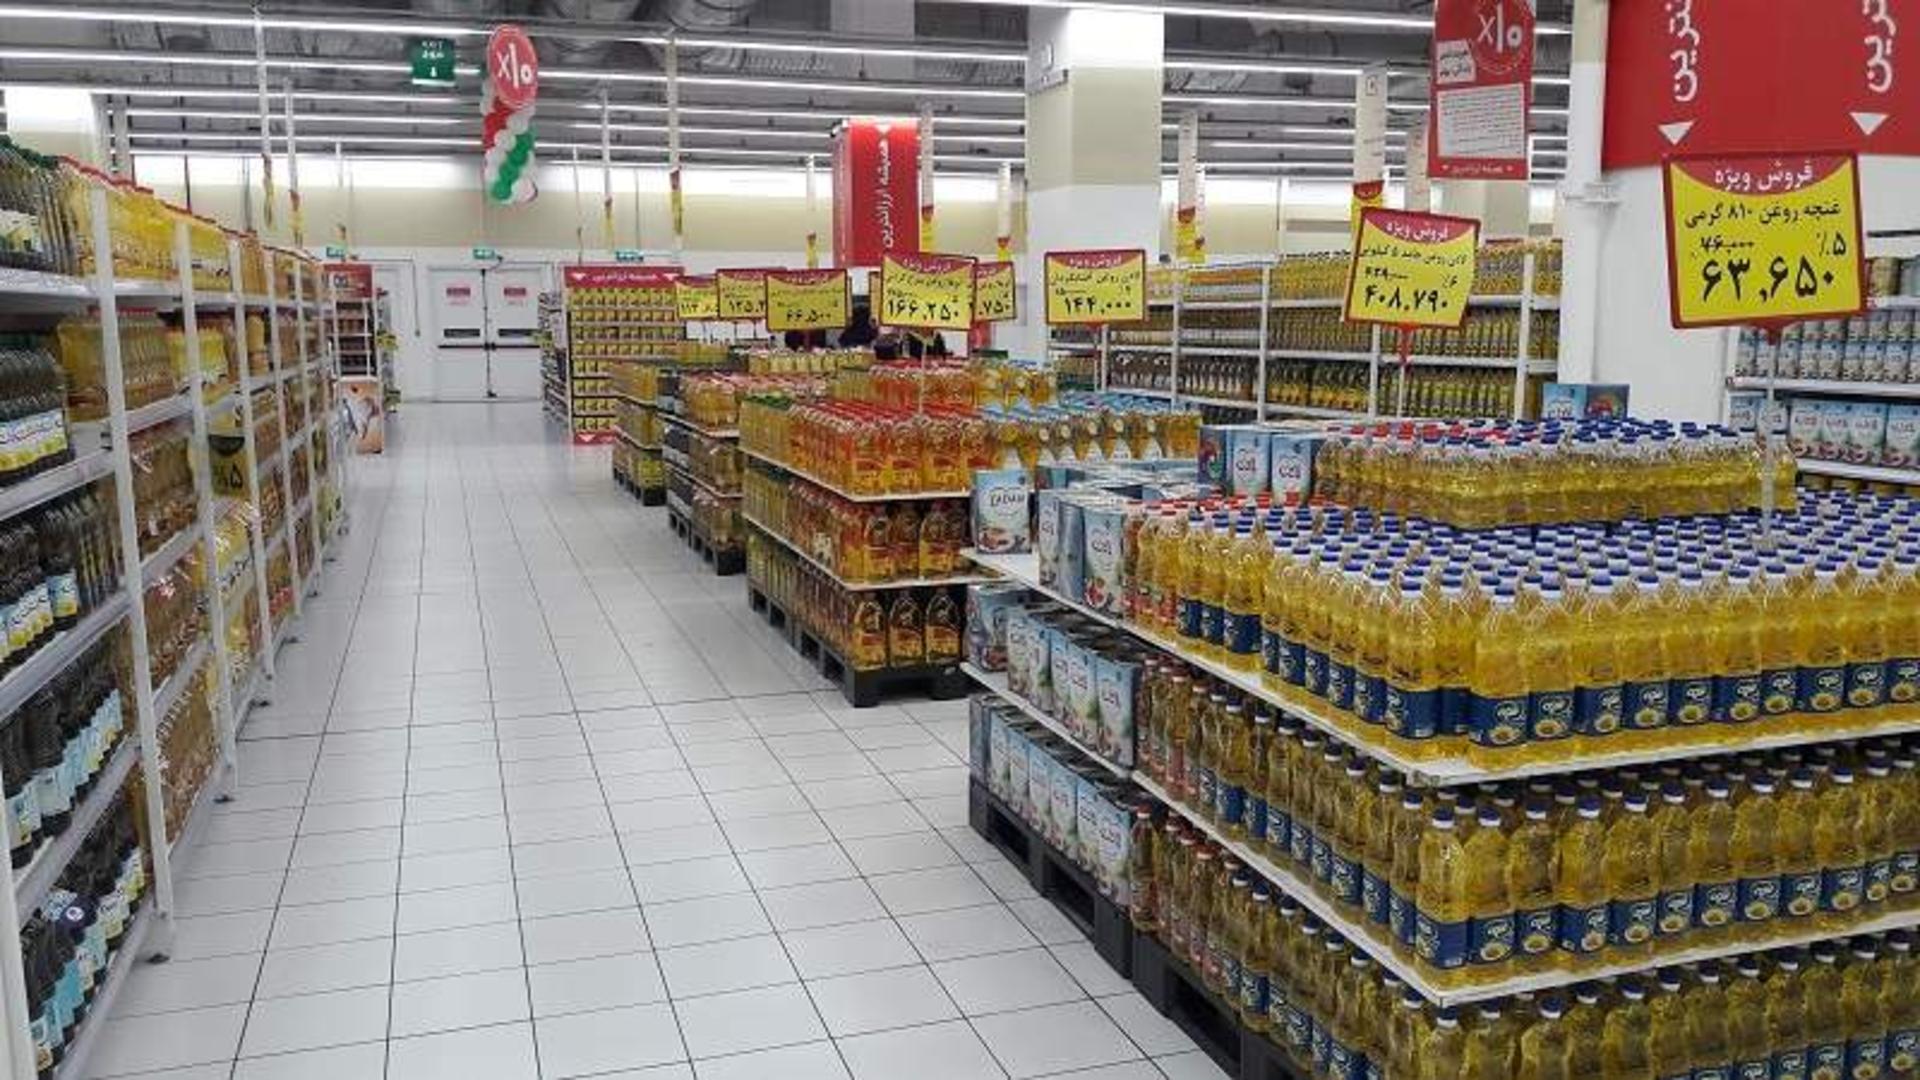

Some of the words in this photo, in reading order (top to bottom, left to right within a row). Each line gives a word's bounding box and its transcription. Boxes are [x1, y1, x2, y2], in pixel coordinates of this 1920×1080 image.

[1715, 167, 1750, 190] ویژه
[1758, 160, 1813, 190] فروش
[1685, 202, 1723, 228] گرمی
[1759, 201, 1799, 224] روغن
[1804, 199, 1841, 221] غنچه
